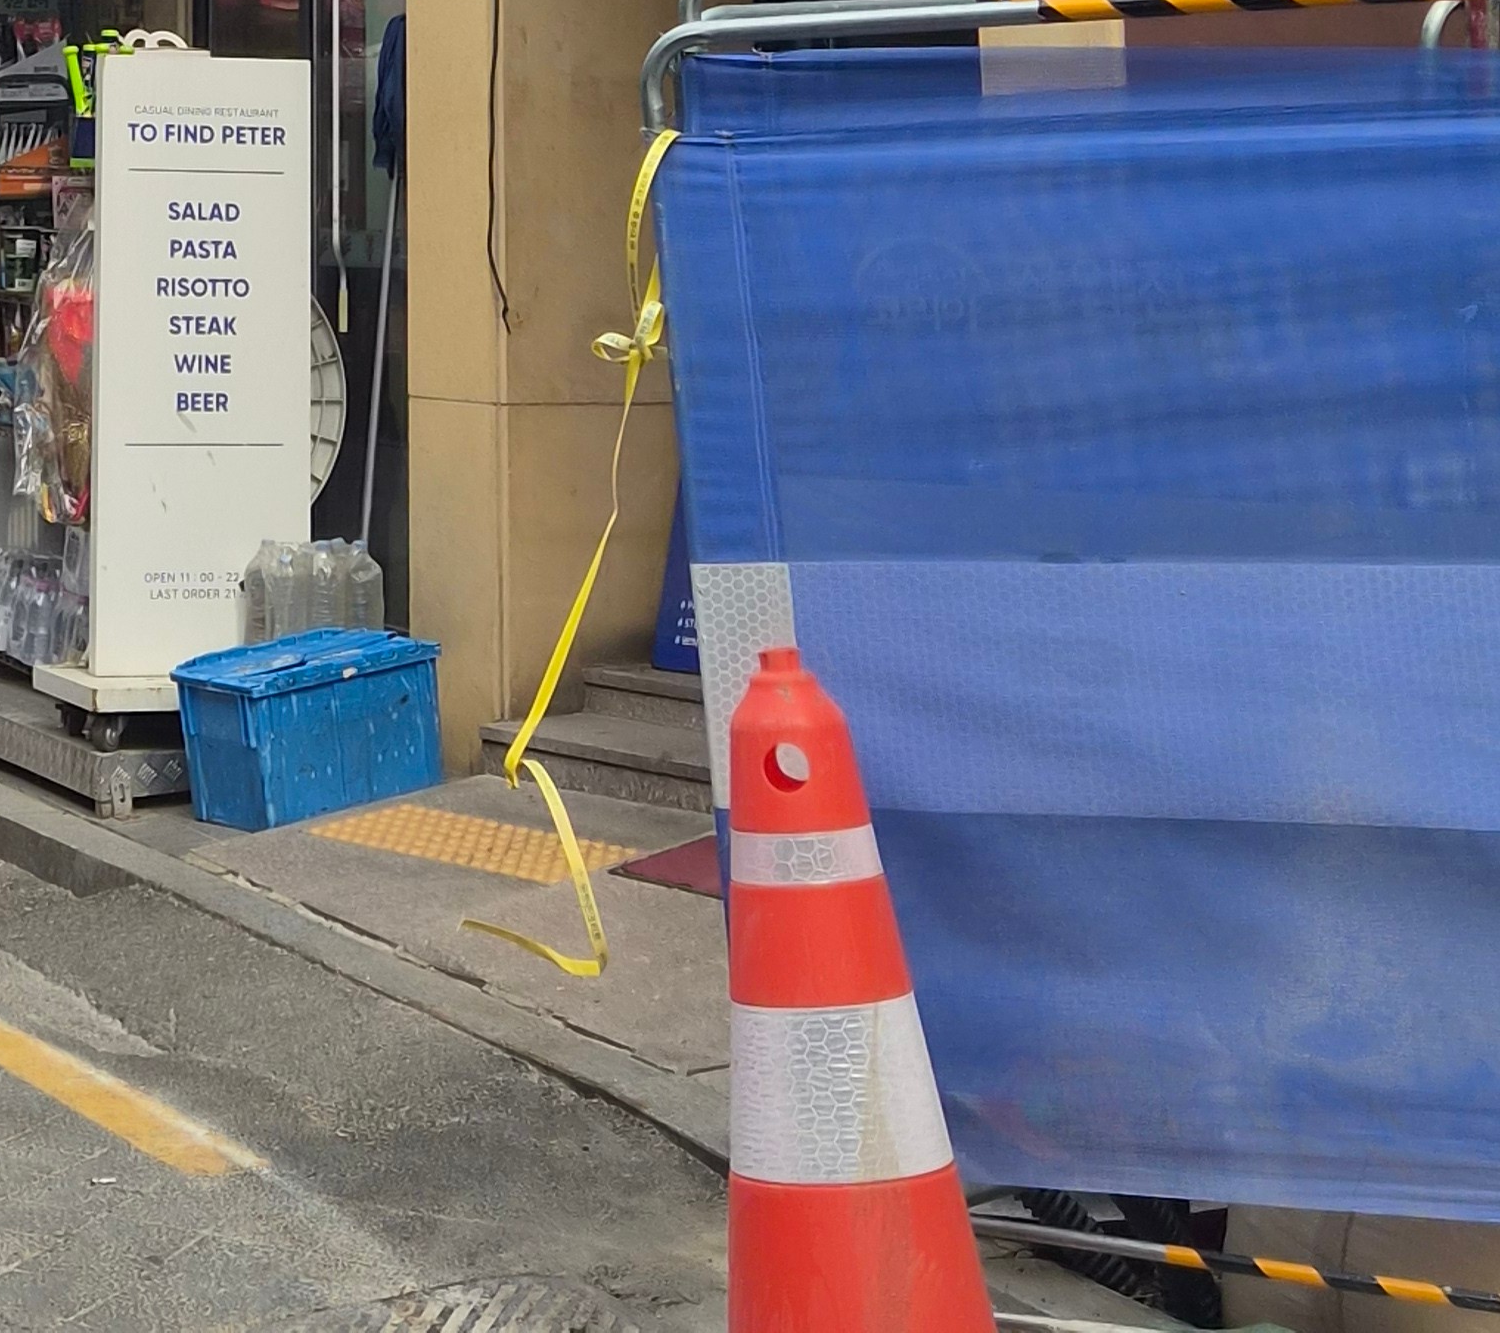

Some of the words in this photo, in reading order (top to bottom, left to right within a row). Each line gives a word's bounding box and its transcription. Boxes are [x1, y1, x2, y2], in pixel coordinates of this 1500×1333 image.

[133, 104, 175, 116] CASUAL
[213, 106, 279, 119] RESTAURANT
[127, 122, 158, 144] TO
[163, 123, 214, 145] FIND
[220, 124, 287, 147] PETER
[167, 202, 241, 223] SALAD
[169, 239, 238, 261] PASTA
[156, 277, 251, 299] RISOTTO
[168, 315, 238, 337] STEAK
[173, 353, 232, 375] WINE
[175, 392, 230, 414] BEER
[144, 572, 177, 584] OPEN
[149, 588, 178, 601] LAST
[181, 588, 221, 601] ORDER
